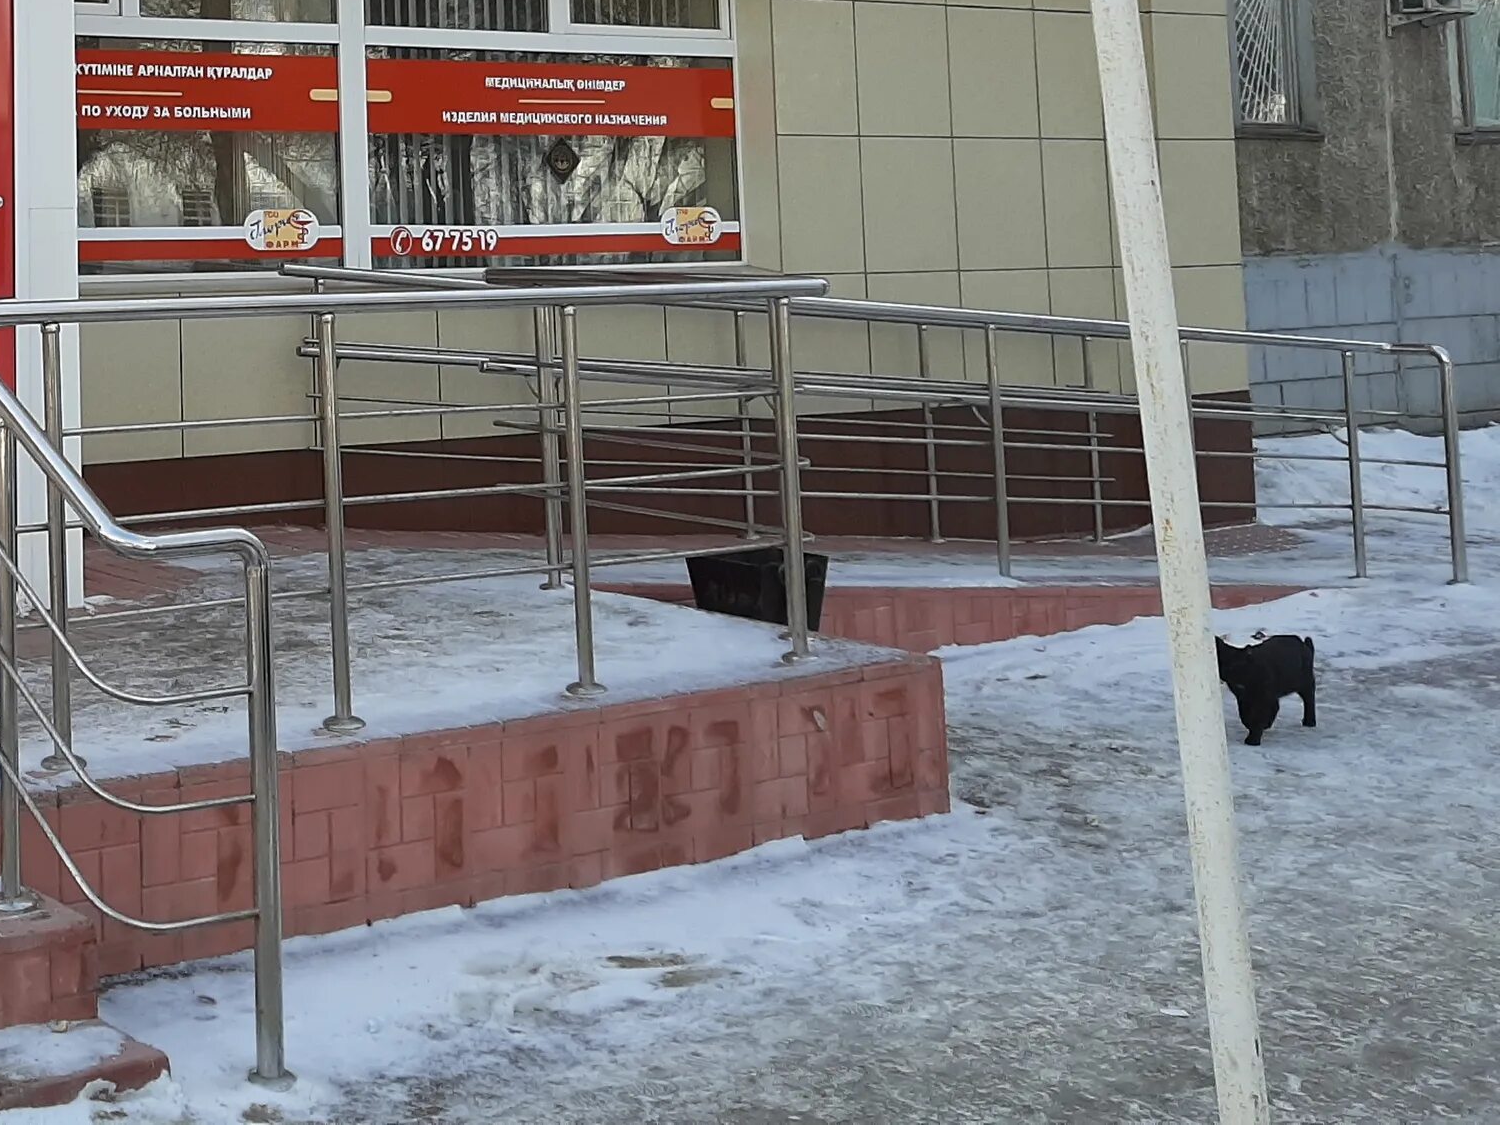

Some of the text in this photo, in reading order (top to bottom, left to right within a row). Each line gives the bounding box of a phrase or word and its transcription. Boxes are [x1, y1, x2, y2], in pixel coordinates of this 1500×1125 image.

[81, 105, 252, 119] ПО УХОДУ ЗА БОЛЬНЫМИ
[442, 110, 668, 126] ИЗДЕЛИЯ МЕДИЦИНСКОГО НАЗНАЧЕНИЯ
